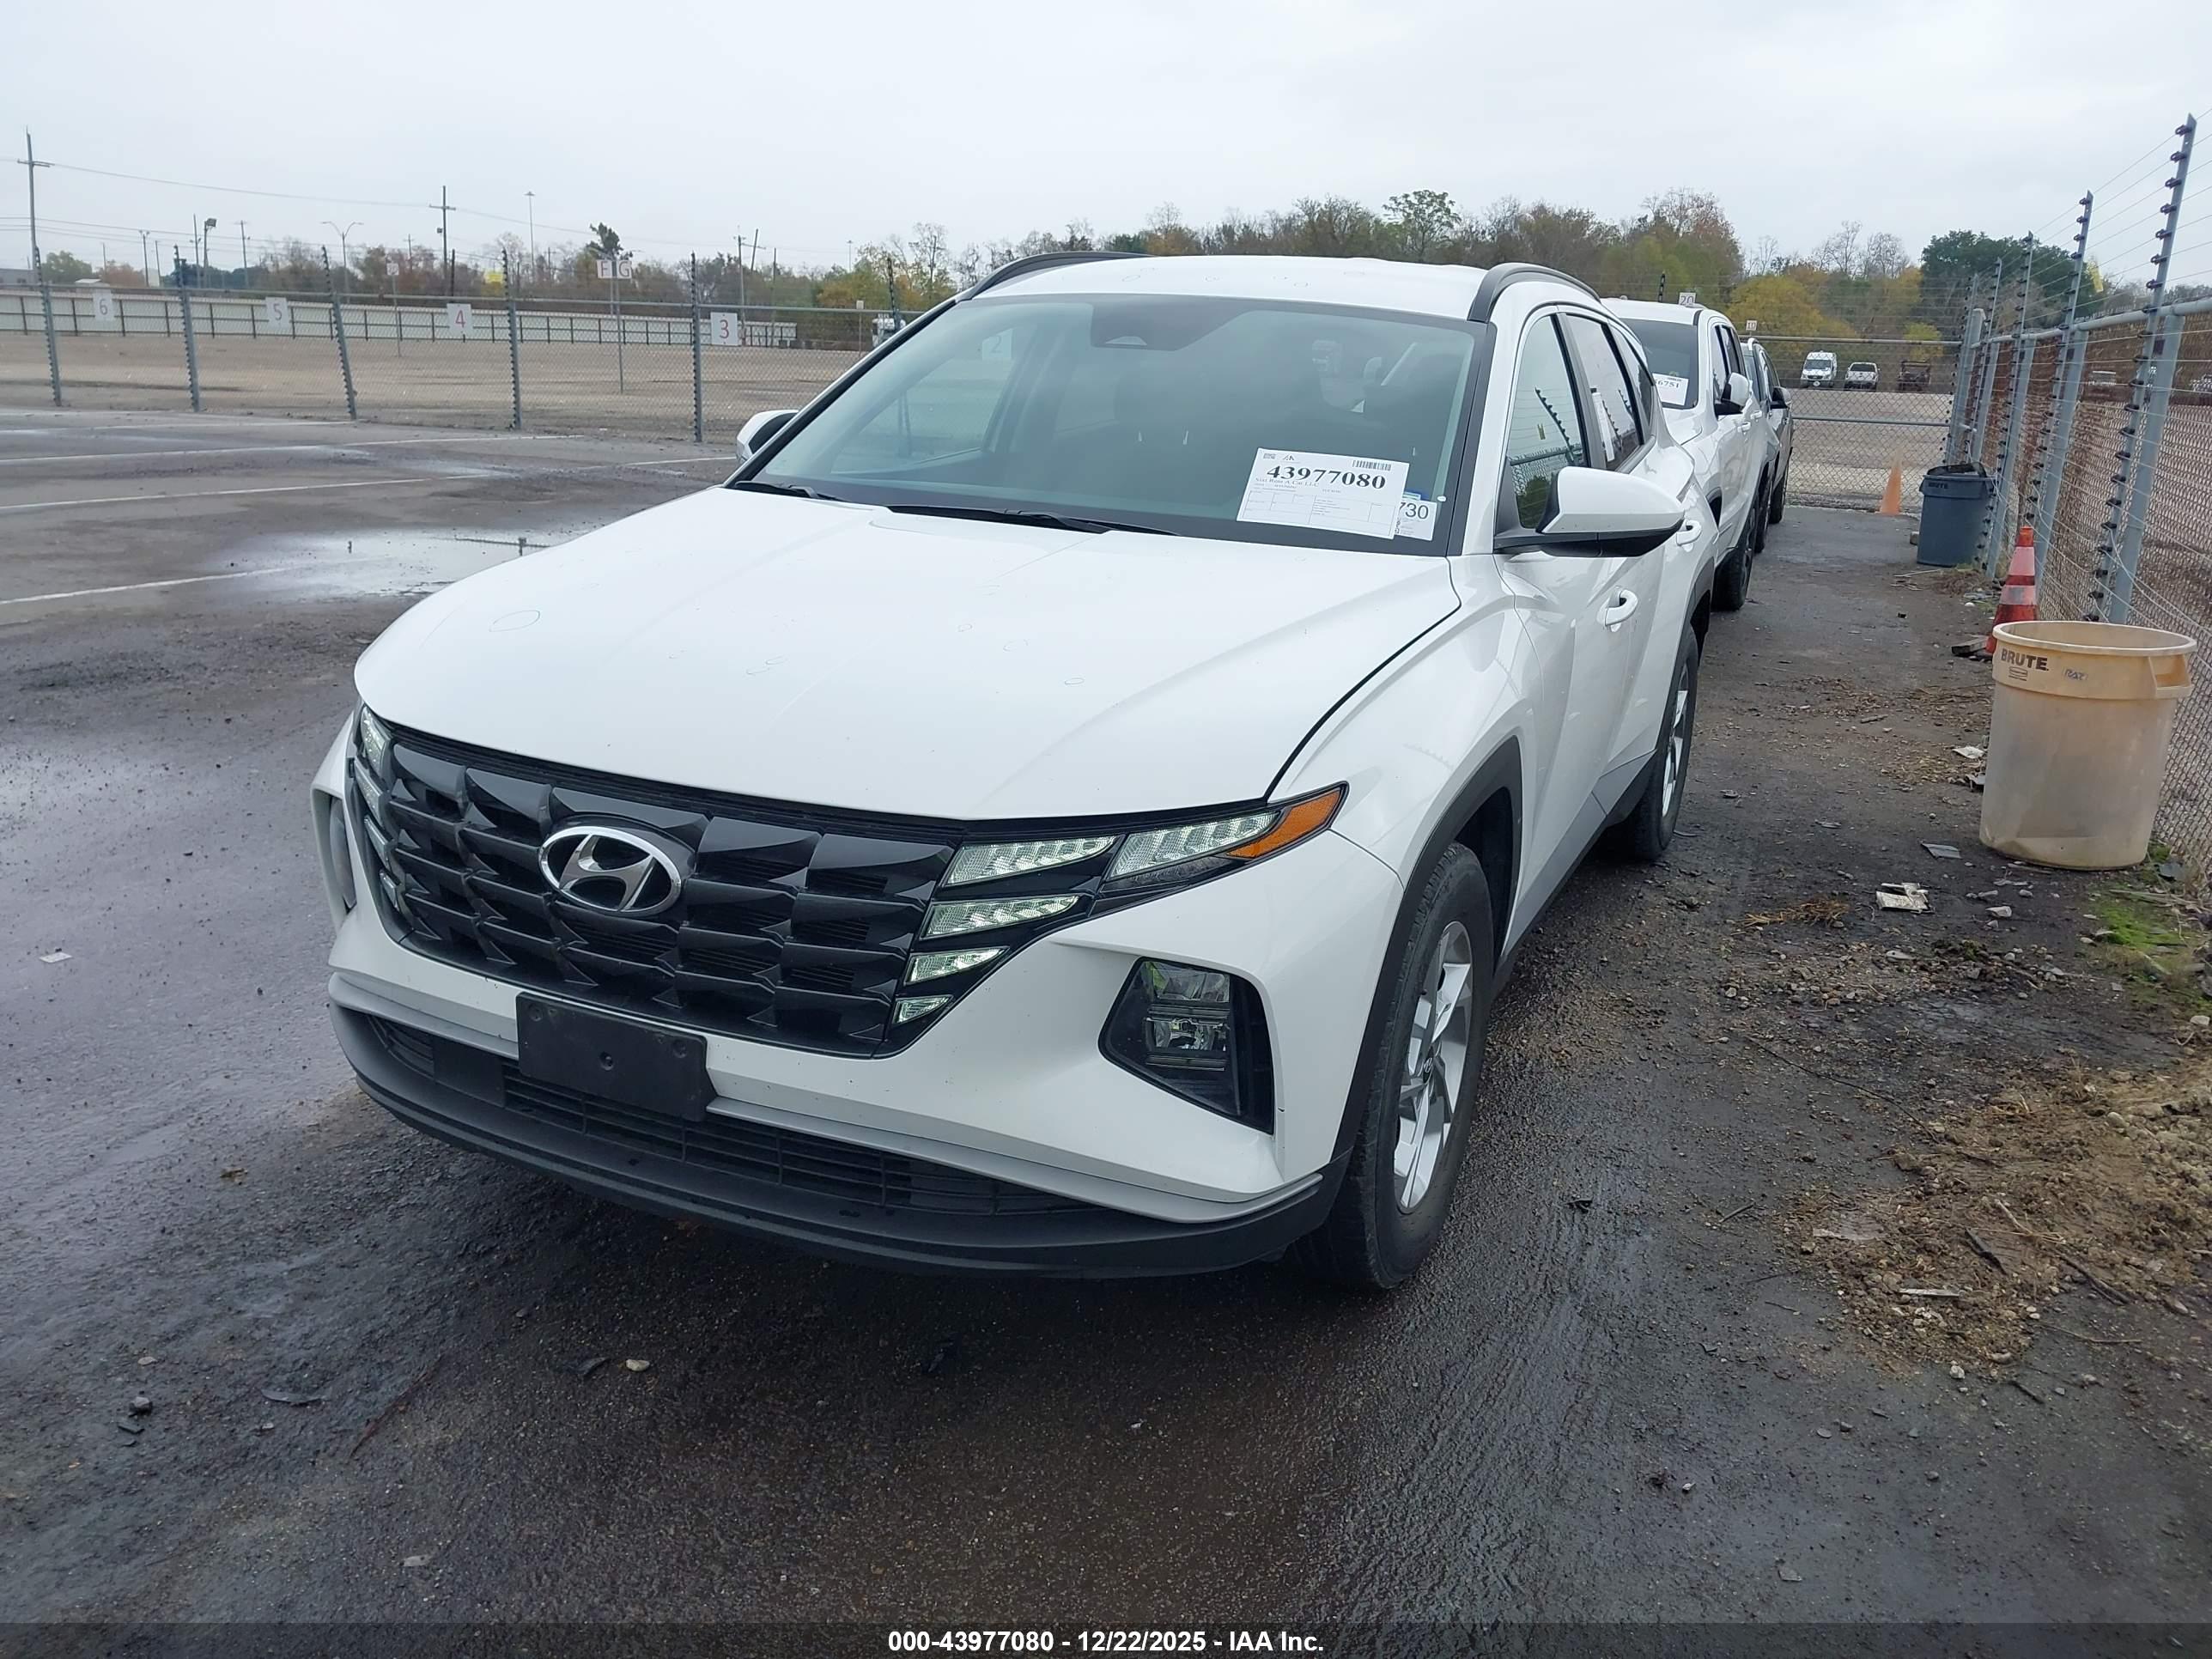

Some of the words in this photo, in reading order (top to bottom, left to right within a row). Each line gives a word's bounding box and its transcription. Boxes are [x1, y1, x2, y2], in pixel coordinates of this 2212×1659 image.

[618, 260, 630, 277] G
[99, 298, 108, 316] 6
[273, 302, 283, 321] 5
[454, 309, 465, 328] 4
[719, 319, 730, 339] 3
[988, 335, 1004, 354] 2
[1266, 465, 1386, 489] 43977080
